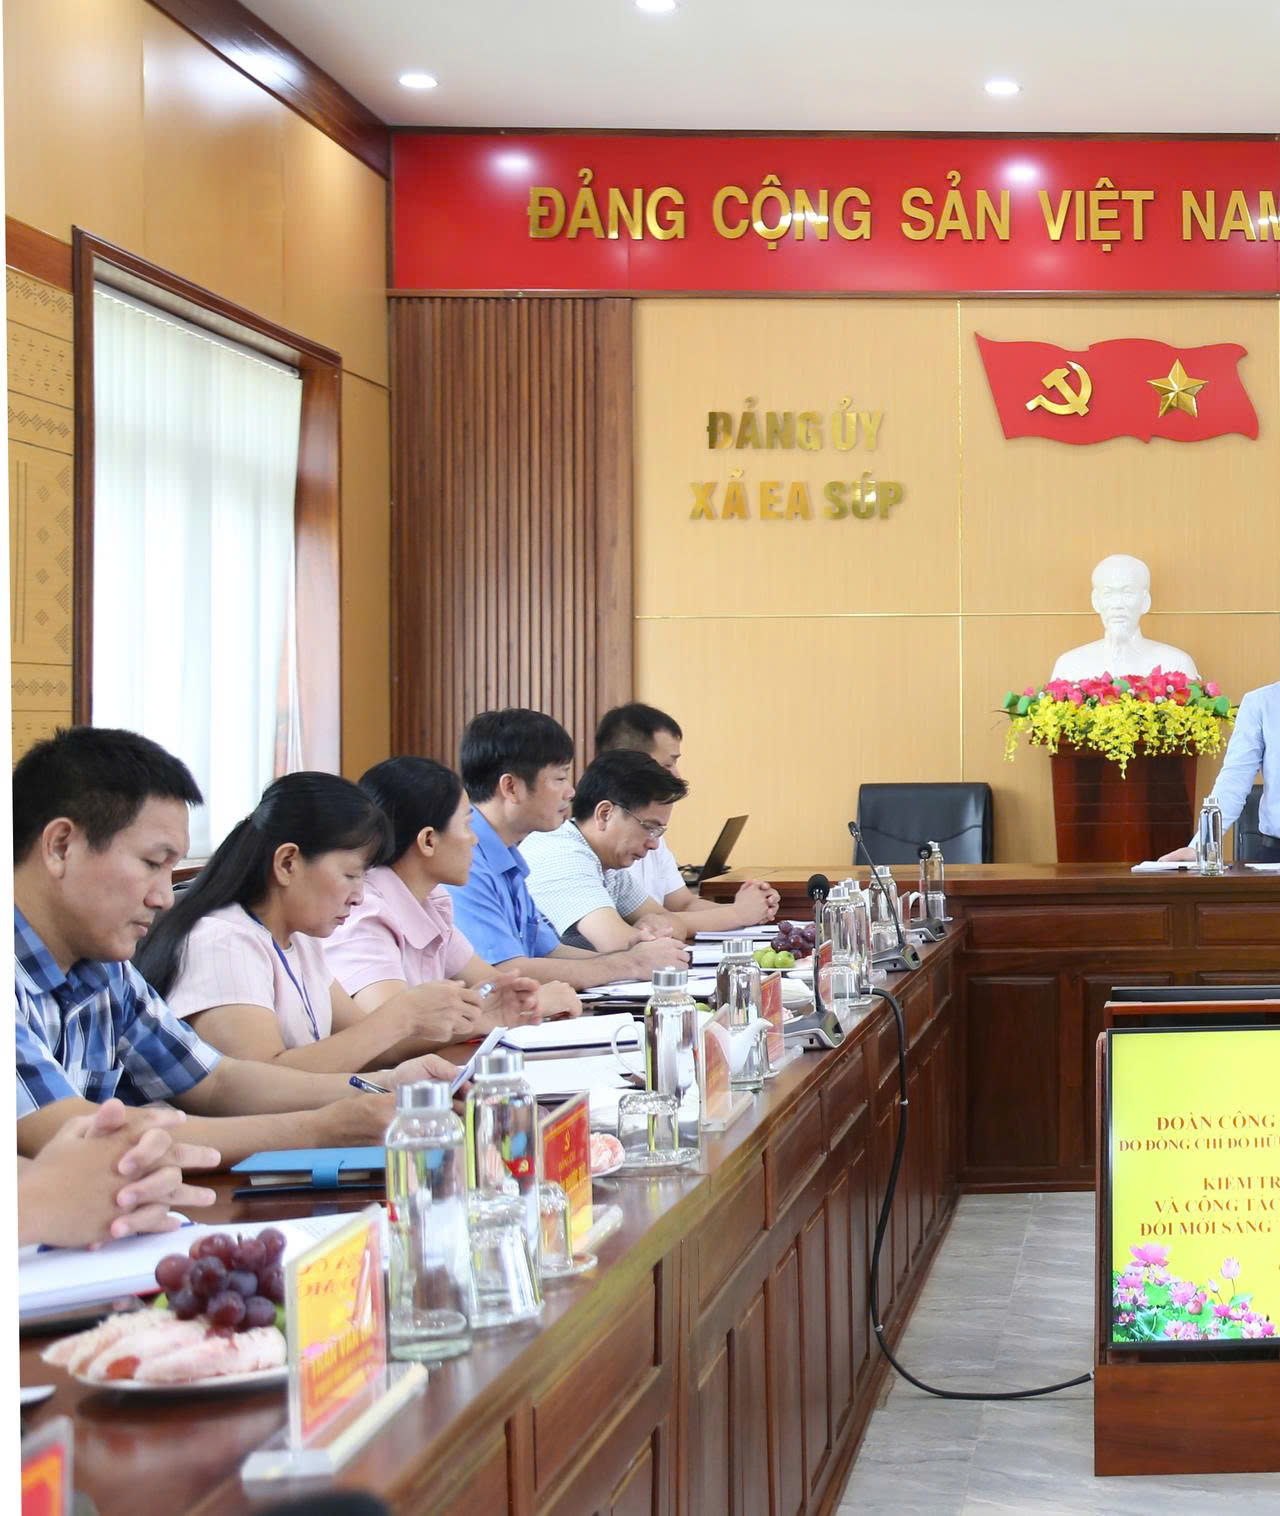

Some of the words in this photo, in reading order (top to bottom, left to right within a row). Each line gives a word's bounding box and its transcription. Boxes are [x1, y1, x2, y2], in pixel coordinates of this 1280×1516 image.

[527, 169, 685, 241] ĐẢNG
[712, 175, 872, 251] CỘNG
[900, 171, 1011, 241] SẢN
[1038, 177, 1154, 252] VIỆT
[706, 396, 823, 451] ĐẢNG
[831, 395, 885, 451] ỦY
[689, 466, 750, 520] XÃ
[759, 481, 812, 520] EA
[823, 467, 904, 520] SÚP
[1218, 1109, 1275, 1130] CÔNG
[1185, 1194, 1238, 1212] CÔNG
